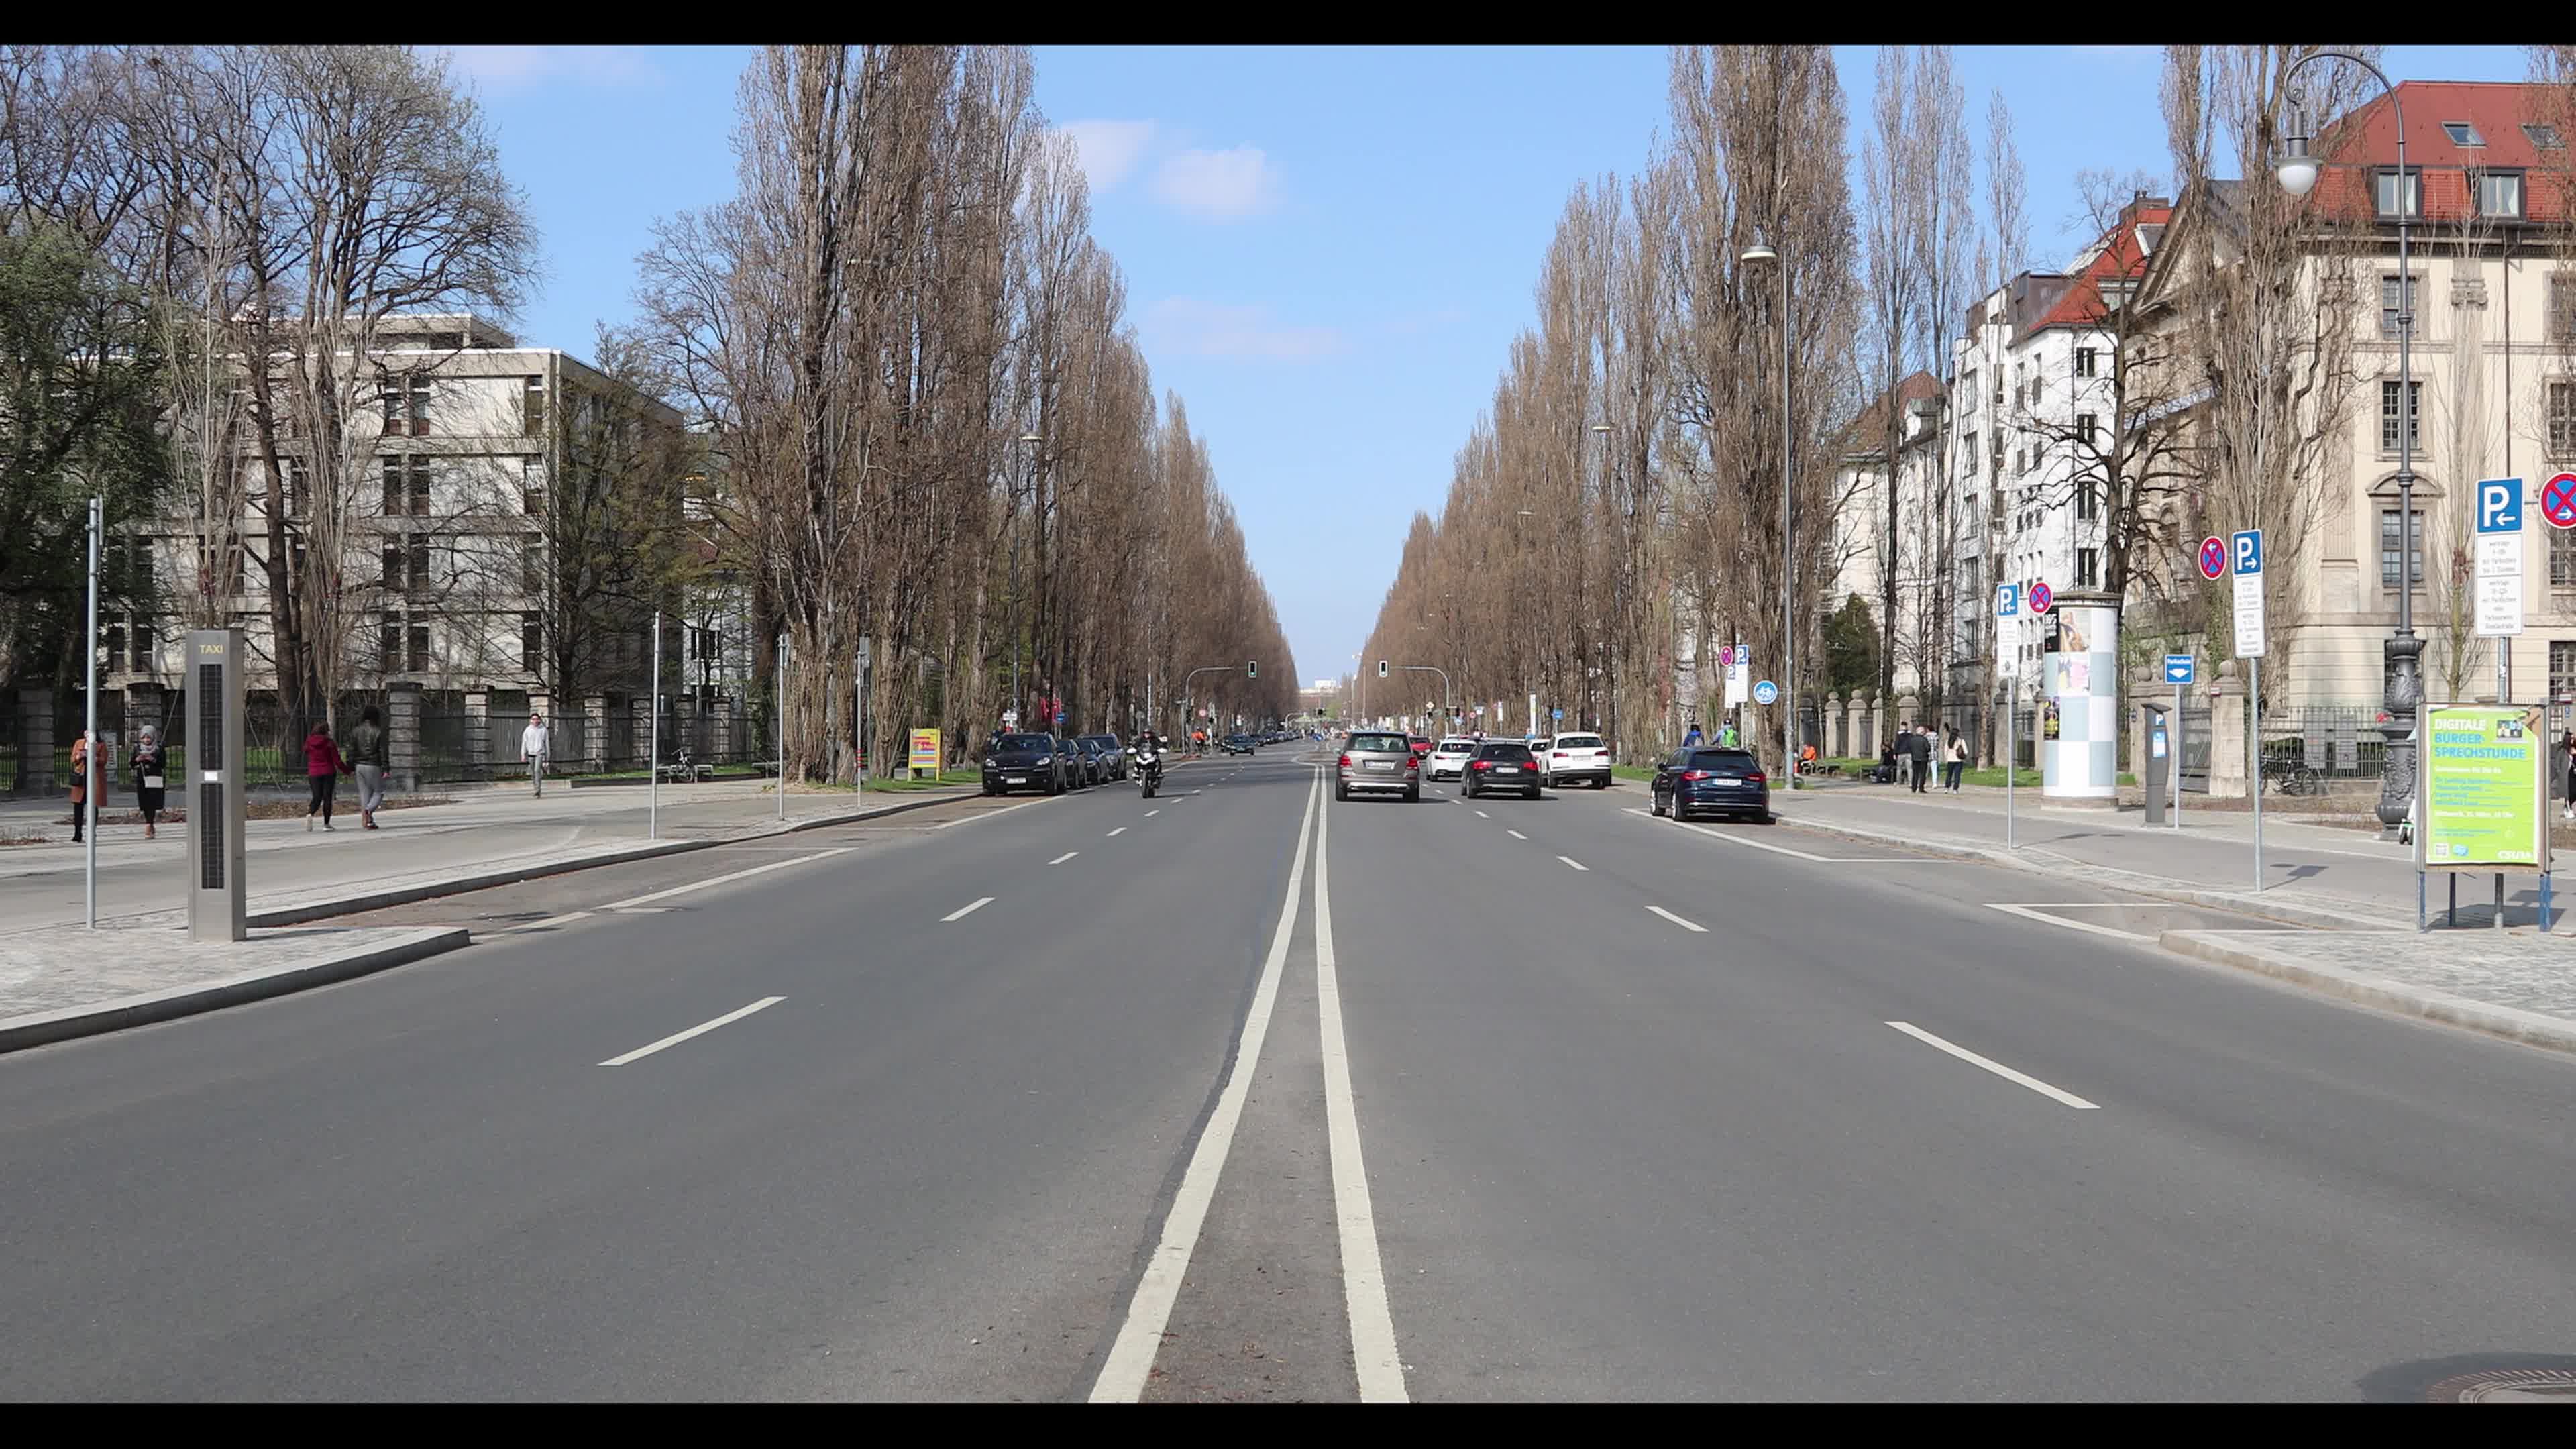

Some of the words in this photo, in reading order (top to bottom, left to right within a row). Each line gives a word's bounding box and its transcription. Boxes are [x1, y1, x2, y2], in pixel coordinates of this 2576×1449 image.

[2484, 486, 2510, 527] P
[2237, 537, 2253, 570] P
[2000, 588, 2012, 613] P
[199, 644, 223, 654] TAXI
[2434, 718, 2486, 731] DIGITALE
[2435, 747, 2526, 759] SPRECHSTUNDE
